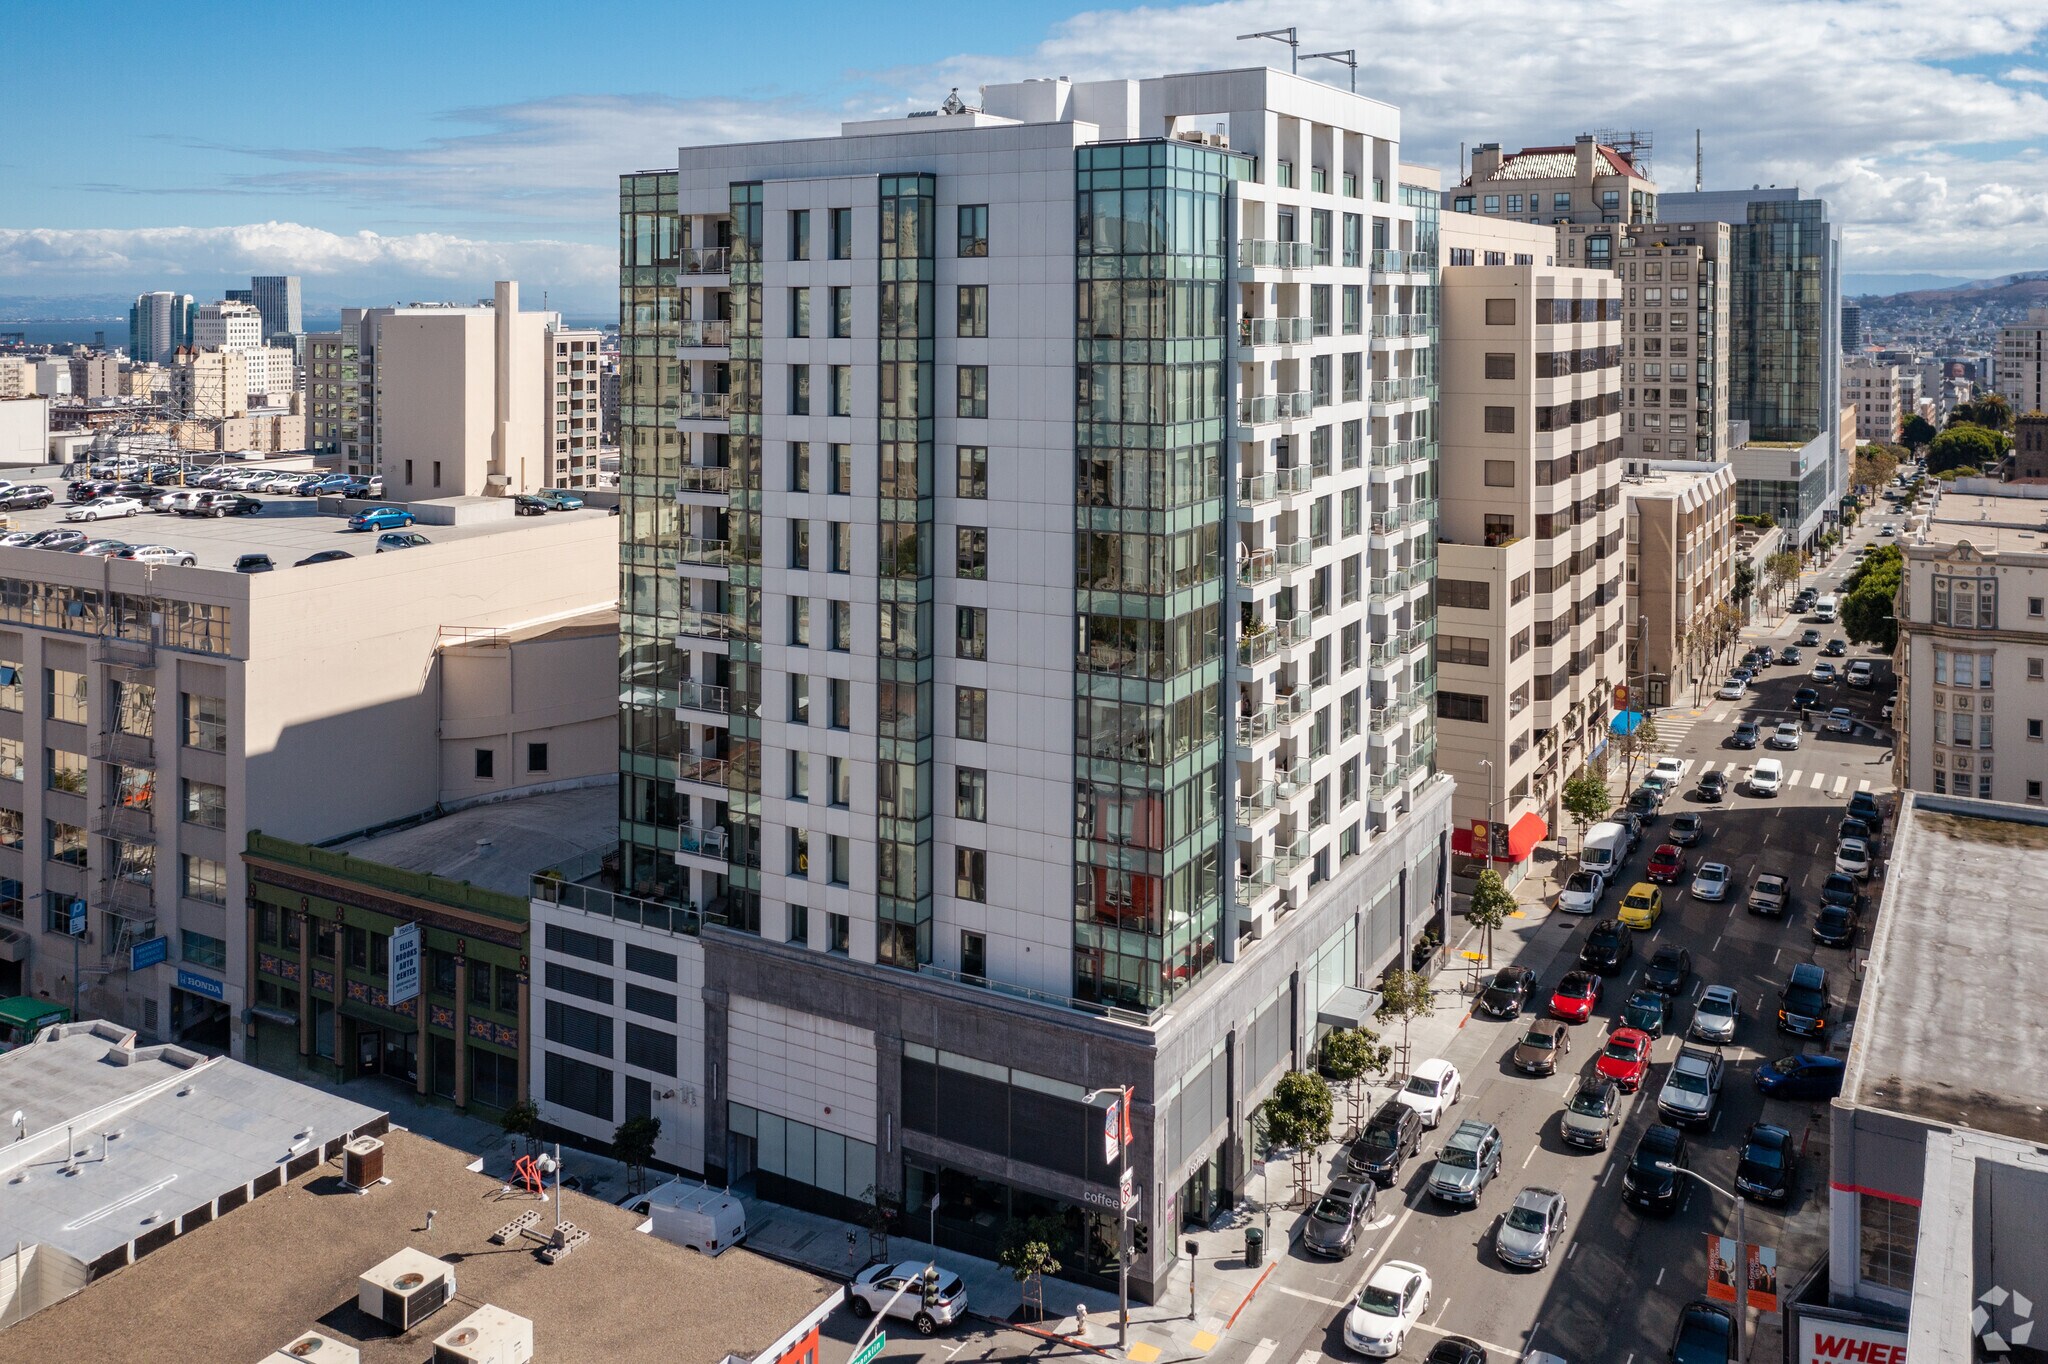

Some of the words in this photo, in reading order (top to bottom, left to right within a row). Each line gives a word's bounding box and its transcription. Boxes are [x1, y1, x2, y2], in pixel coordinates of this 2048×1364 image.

[400, 940, 414, 952] ELLIS
[395, 947, 418, 963] BROOKS
[399, 958, 414, 971] AUTO
[396, 966, 417, 981] CENTER
[187, 977, 222, 994] HONDA
[1084, 1190, 1120, 1209] coffee
[854, 1341, 881, 1364] anklin
[1814, 1332, 1908, 1364] WHEE
